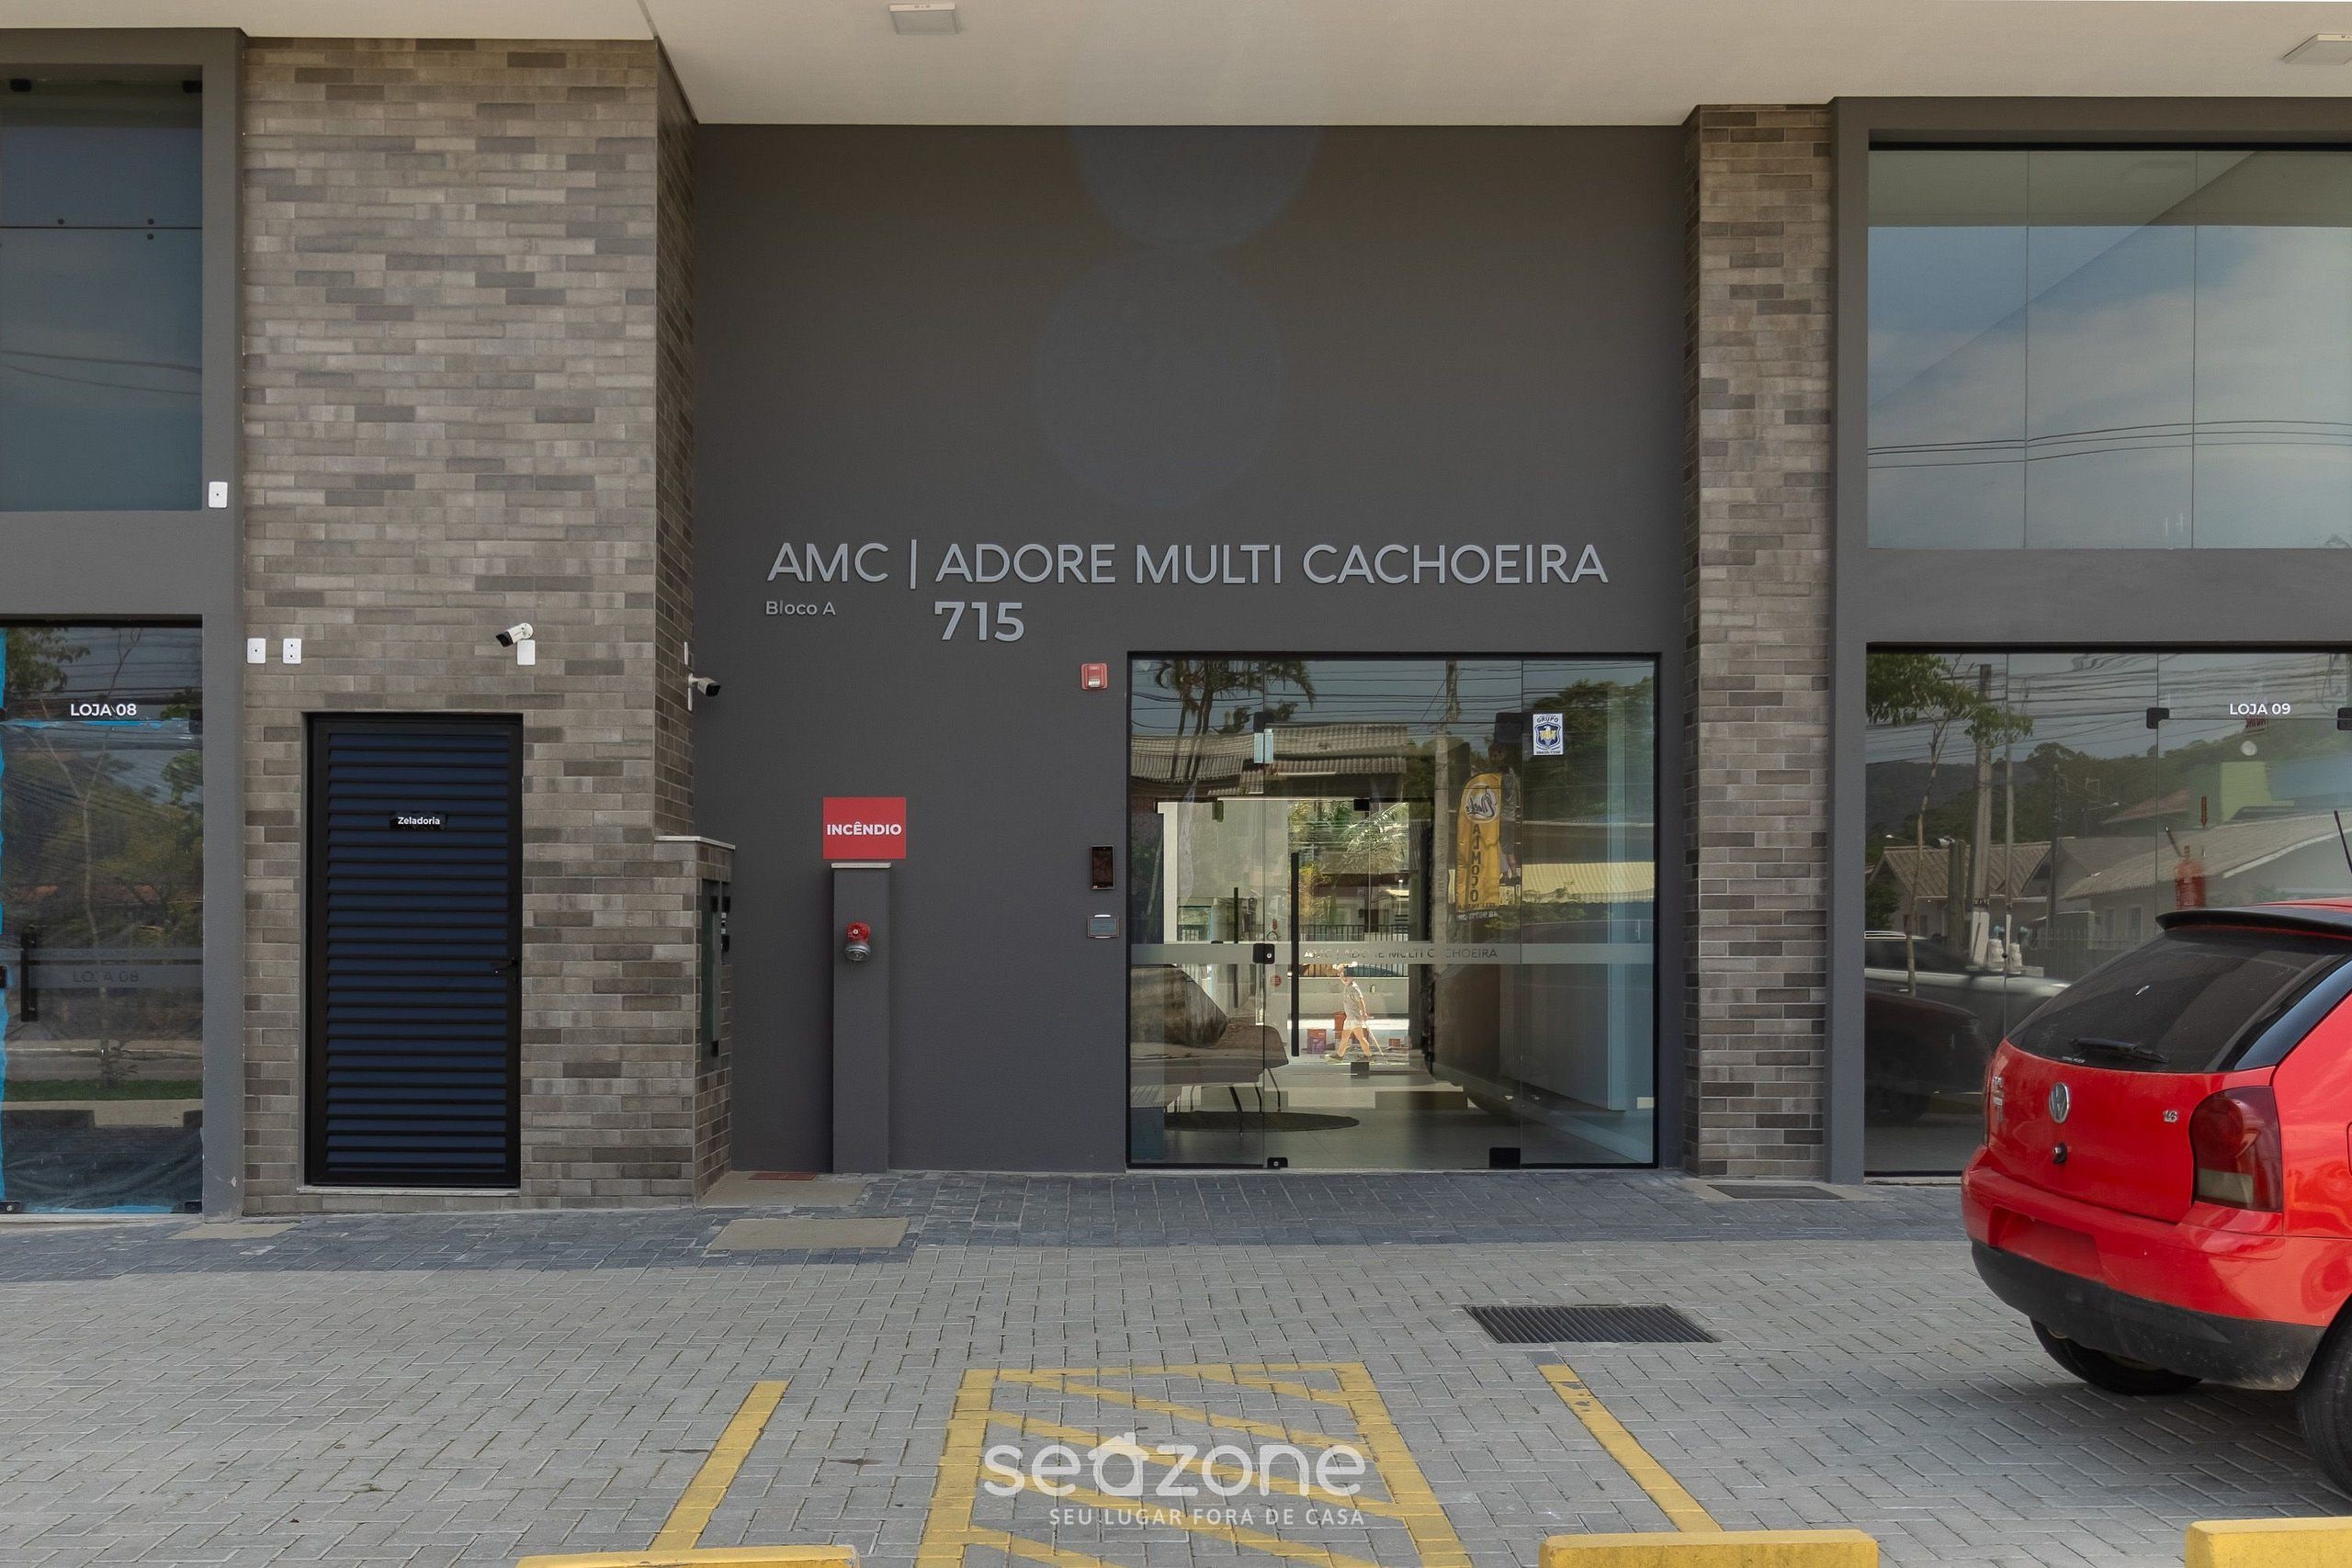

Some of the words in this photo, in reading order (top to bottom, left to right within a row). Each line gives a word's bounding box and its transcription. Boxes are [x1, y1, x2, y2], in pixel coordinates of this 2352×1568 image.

[766, 542, 889, 583] AMC
[934, 543, 1116, 584] ADORE
[1135, 544, 1282, 584] MULTI
[1303, 544, 1609, 584] CACHOEIRA
[765, 600, 818, 615] Bloco
[822, 602, 837, 615] A
[933, 601, 1025, 642] 715
[70, 703, 112, 716] LOJA
[116, 703, 137, 716] 08
[2230, 703, 2267, 716] LOJA
[2271, 703, 2291, 716] 09
[397, 816, 441, 825] Zeladoria
[826, 820, 902, 836] INCÊNDIO
[1427, 947, 1498, 959] CCHOEIRA
